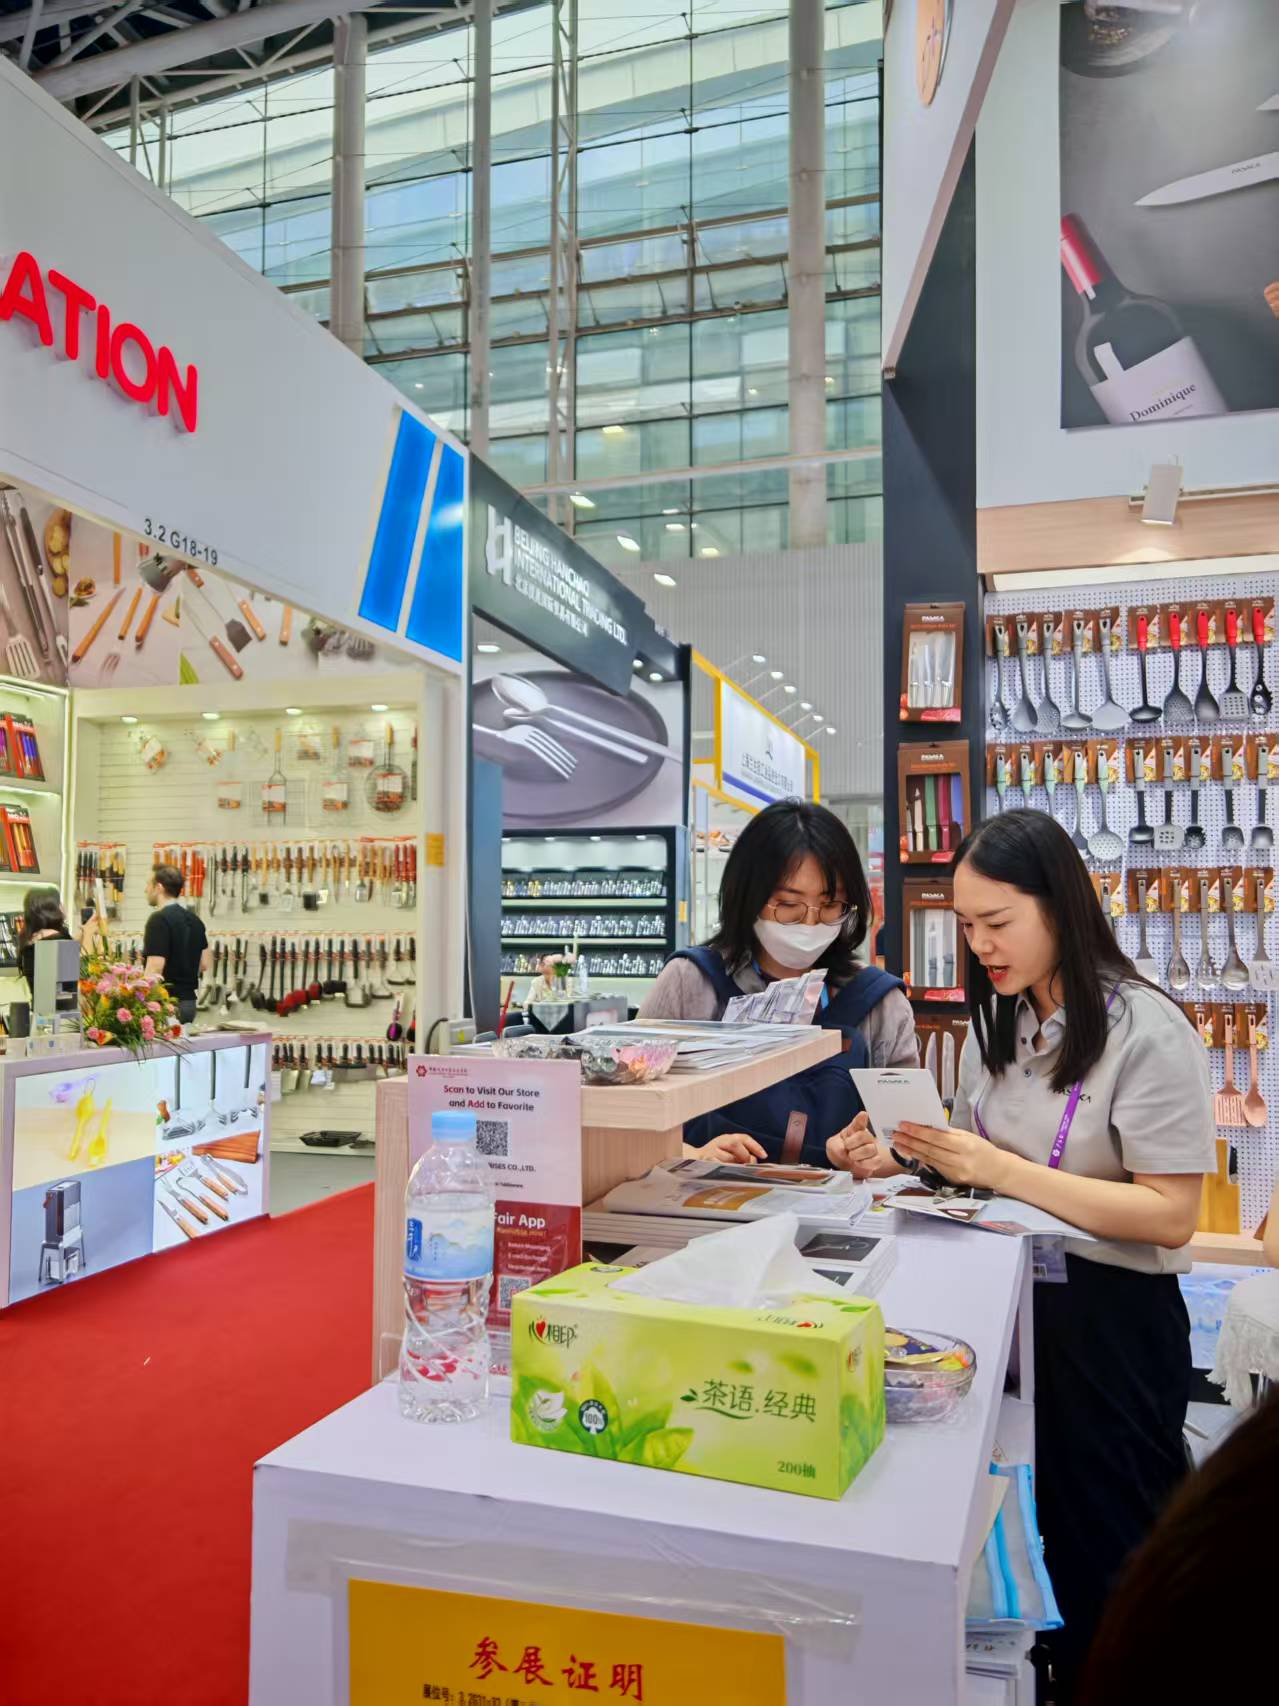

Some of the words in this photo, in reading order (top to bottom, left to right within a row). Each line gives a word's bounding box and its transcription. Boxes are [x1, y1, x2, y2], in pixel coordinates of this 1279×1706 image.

[0, 251, 198, 433] ATION
[1129, 384, 1196, 422] Dominique
[514, 525, 551, 567] BEIJING
[514, 547, 581, 612] INTERNATIONAL
[581, 597, 612, 635] TRADING
[443, 1085, 464, 1094] Scan
[466, 1087, 475, 1095] to
[477, 1087, 496, 1096] Visit
[498, 1088, 514, 1097] Our
[516, 1089, 540, 1098] Store
[449, 1100, 466, 1108] and
[467, 1100, 485, 1109] Add
[487, 1102, 496, 1110] to
[498, 1102, 535, 1112] Favorite
[518, 1214, 546, 1230] App
[776, 1460, 817, 1479] 200抽
[468, 1636, 644, 1702] 参展证明
